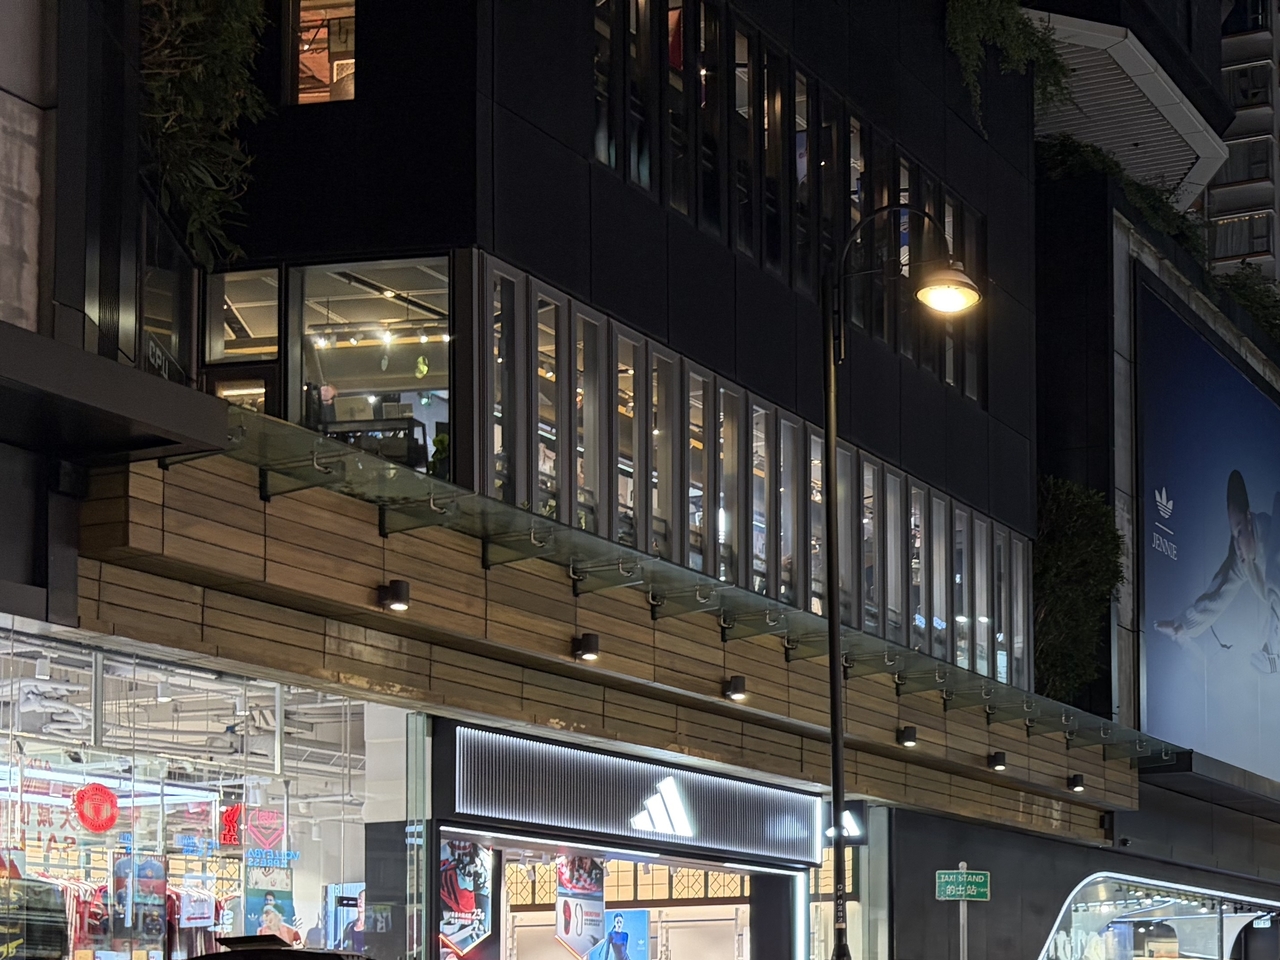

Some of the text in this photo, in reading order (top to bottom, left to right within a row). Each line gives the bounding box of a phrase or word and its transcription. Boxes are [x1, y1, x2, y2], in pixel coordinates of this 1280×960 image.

[1152, 532, 1177, 561] JENNIE
[940, 874, 985, 882] TAXI STAND
[946, 884, 977, 895] 的士站
